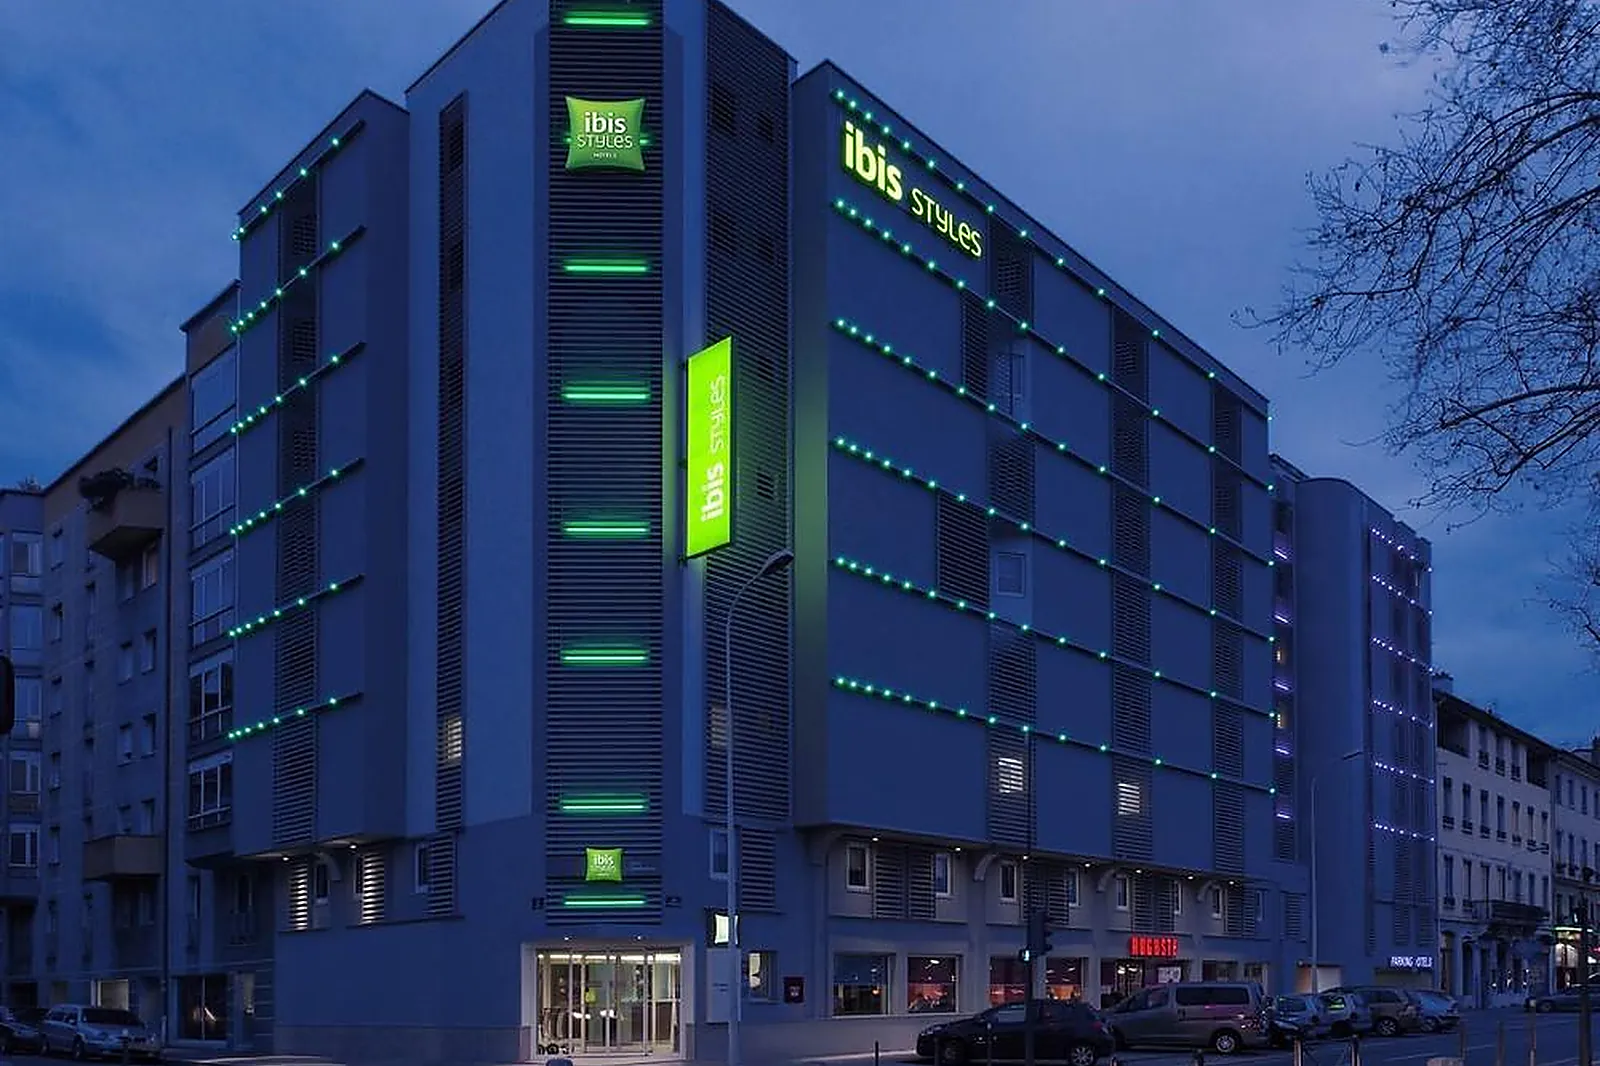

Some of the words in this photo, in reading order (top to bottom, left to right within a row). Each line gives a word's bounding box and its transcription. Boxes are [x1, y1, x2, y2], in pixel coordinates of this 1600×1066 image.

[584, 111, 627, 133] ibis
[845, 120, 903, 201] ibis
[701, 463, 724, 522] ibis
